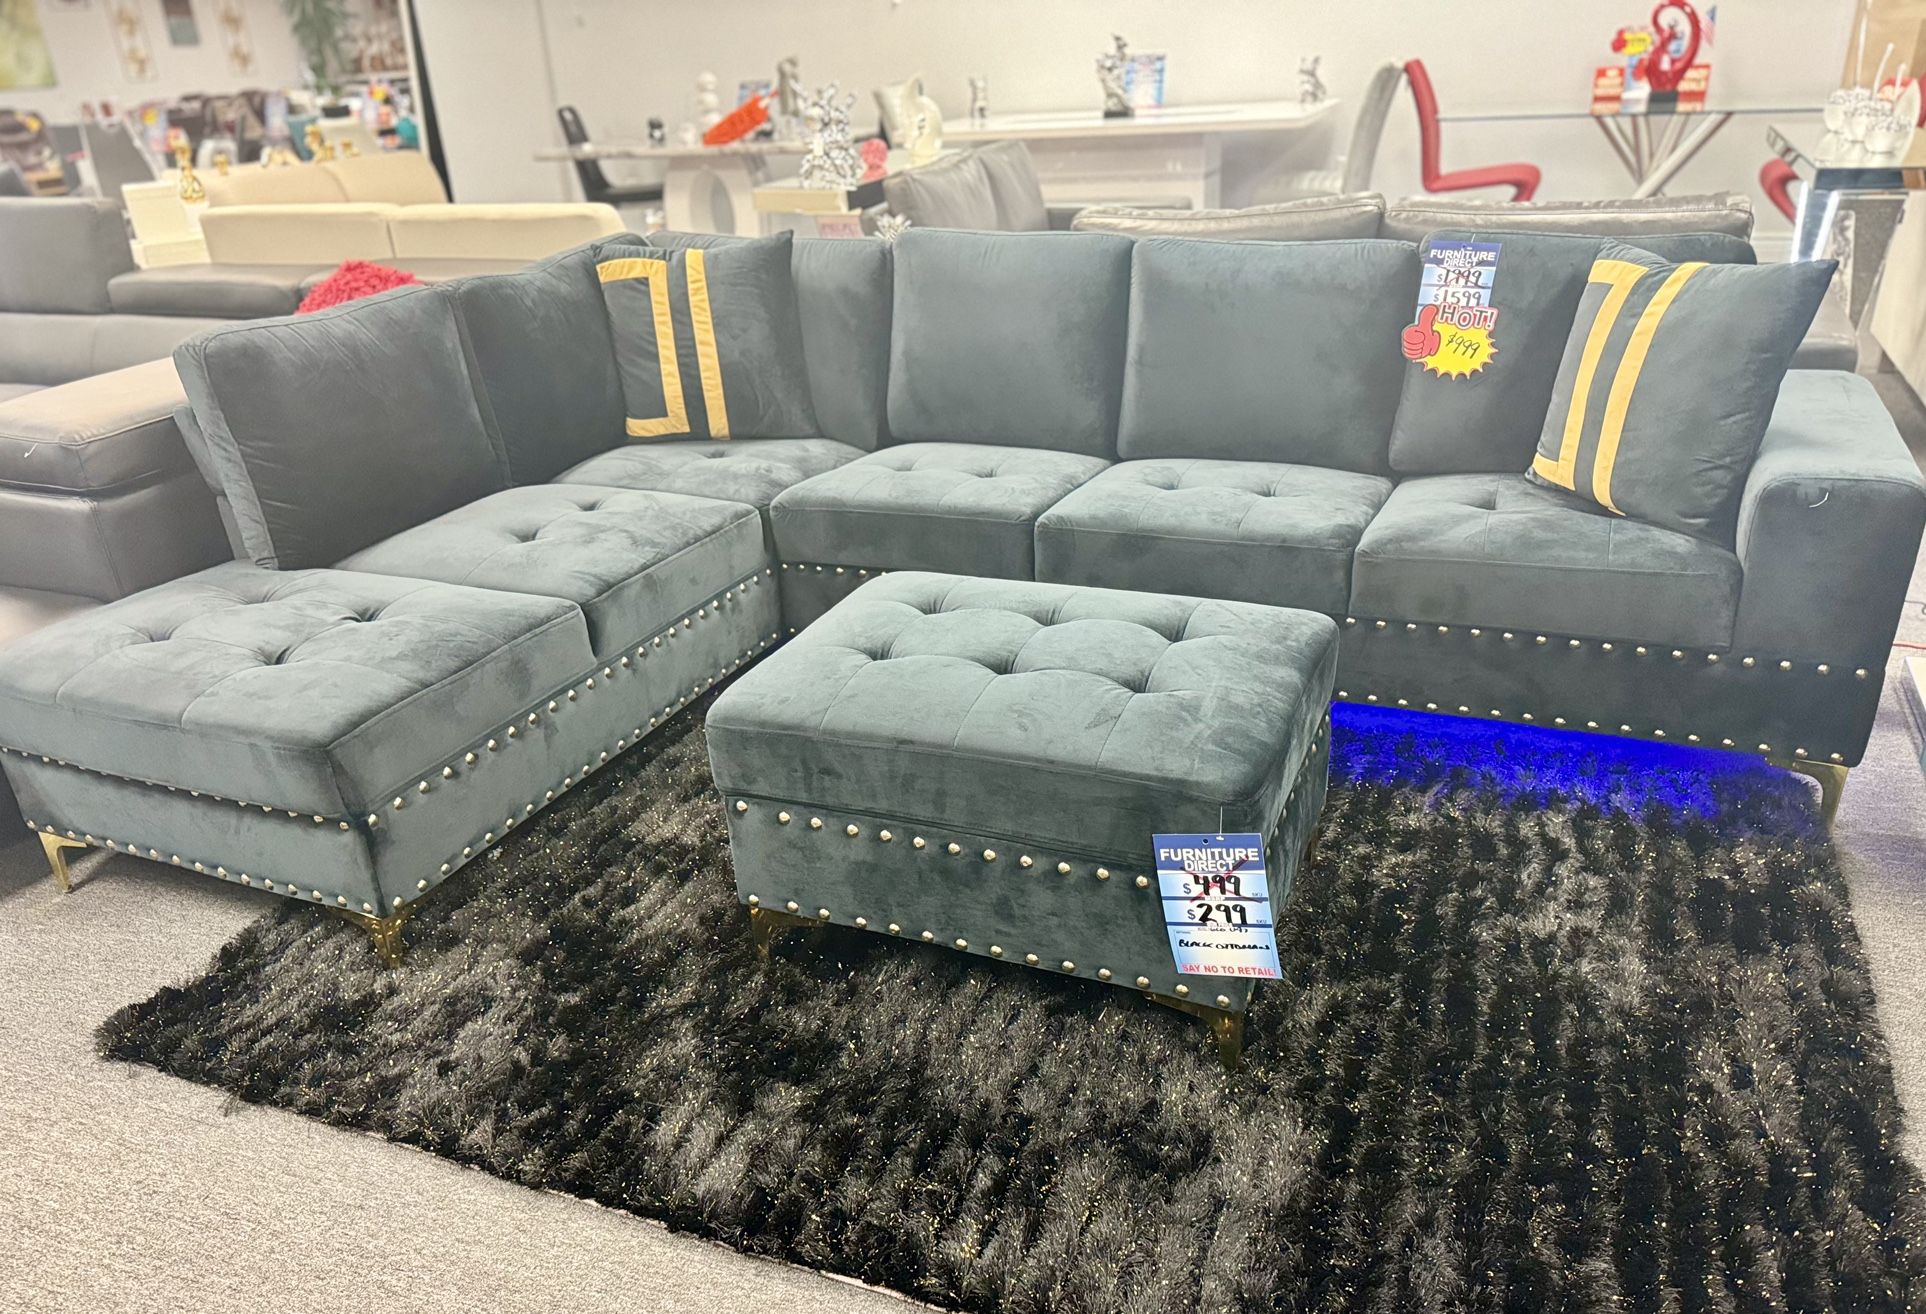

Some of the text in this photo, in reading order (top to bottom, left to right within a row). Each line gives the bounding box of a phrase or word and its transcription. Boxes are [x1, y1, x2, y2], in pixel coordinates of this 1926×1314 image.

[1429, 249, 1497, 261] FURNITURE
[1443, 259, 1477, 267] DIRECT
[1439, 304, 1496, 329] HOT!
[1159, 848, 1260, 861] FURNITURE
[1184, 860, 1235, 871] DIRECT
[1182, 964, 1200, 973] SAY
[1204, 965, 1219, 973] NO
[1220, 966, 1235, 974] TO
